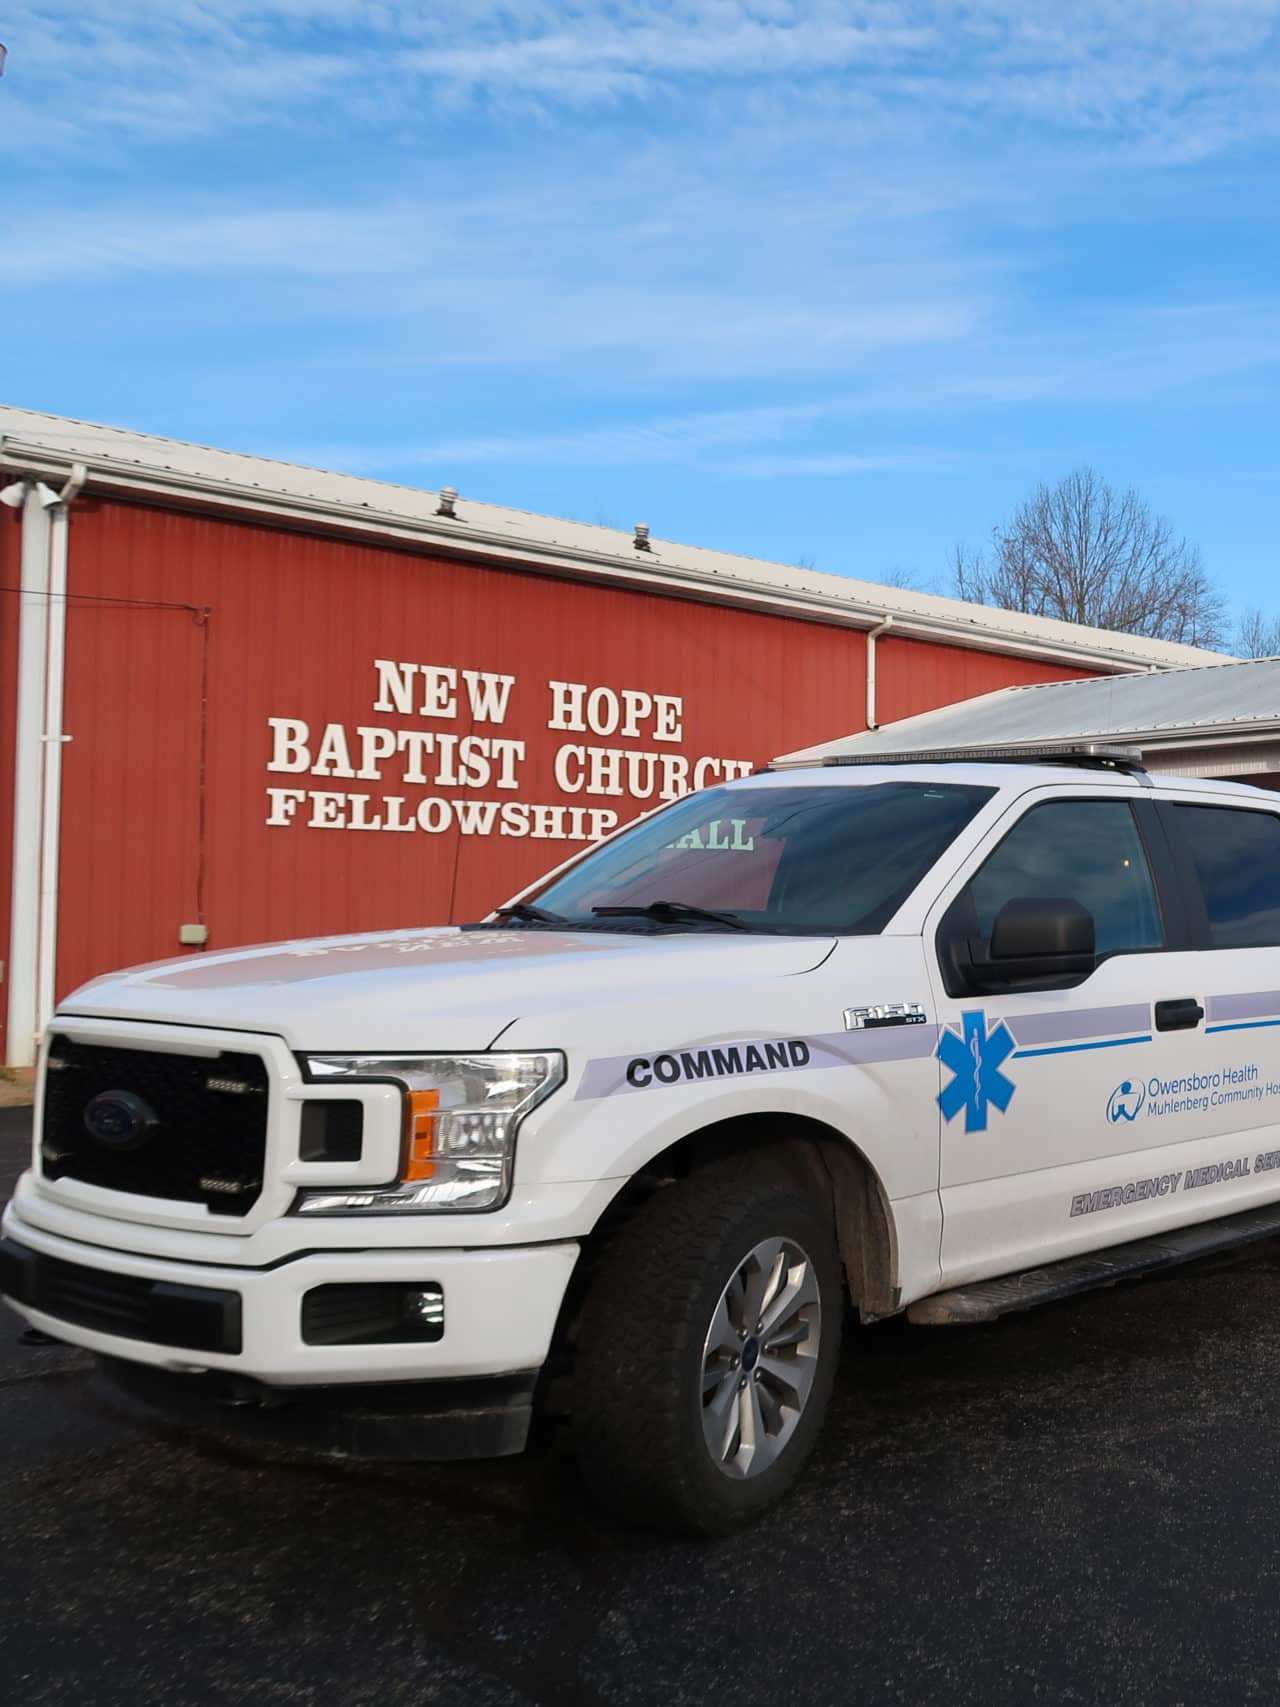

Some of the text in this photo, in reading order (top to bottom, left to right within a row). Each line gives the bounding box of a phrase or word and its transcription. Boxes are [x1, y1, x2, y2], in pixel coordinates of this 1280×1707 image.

[373, 658, 683, 743] NEW HOPE
[266, 716, 525, 790] BAPTIST
[265, 787, 754, 852] FELLOWSHIP ALL
[905, 1015, 926, 1023] STX
[626, 1040, 811, 1088] COMMAND
[1148, 1064, 1258, 1097] Owensboro Health
[1147, 1097, 1209, 1117] Muhlenberg
[1210, 1084, 1264, 1107] Community
[1070, 1173, 1182, 1217] EMERGENCY
[1183, 1158, 1250, 1190] MEDICAL
